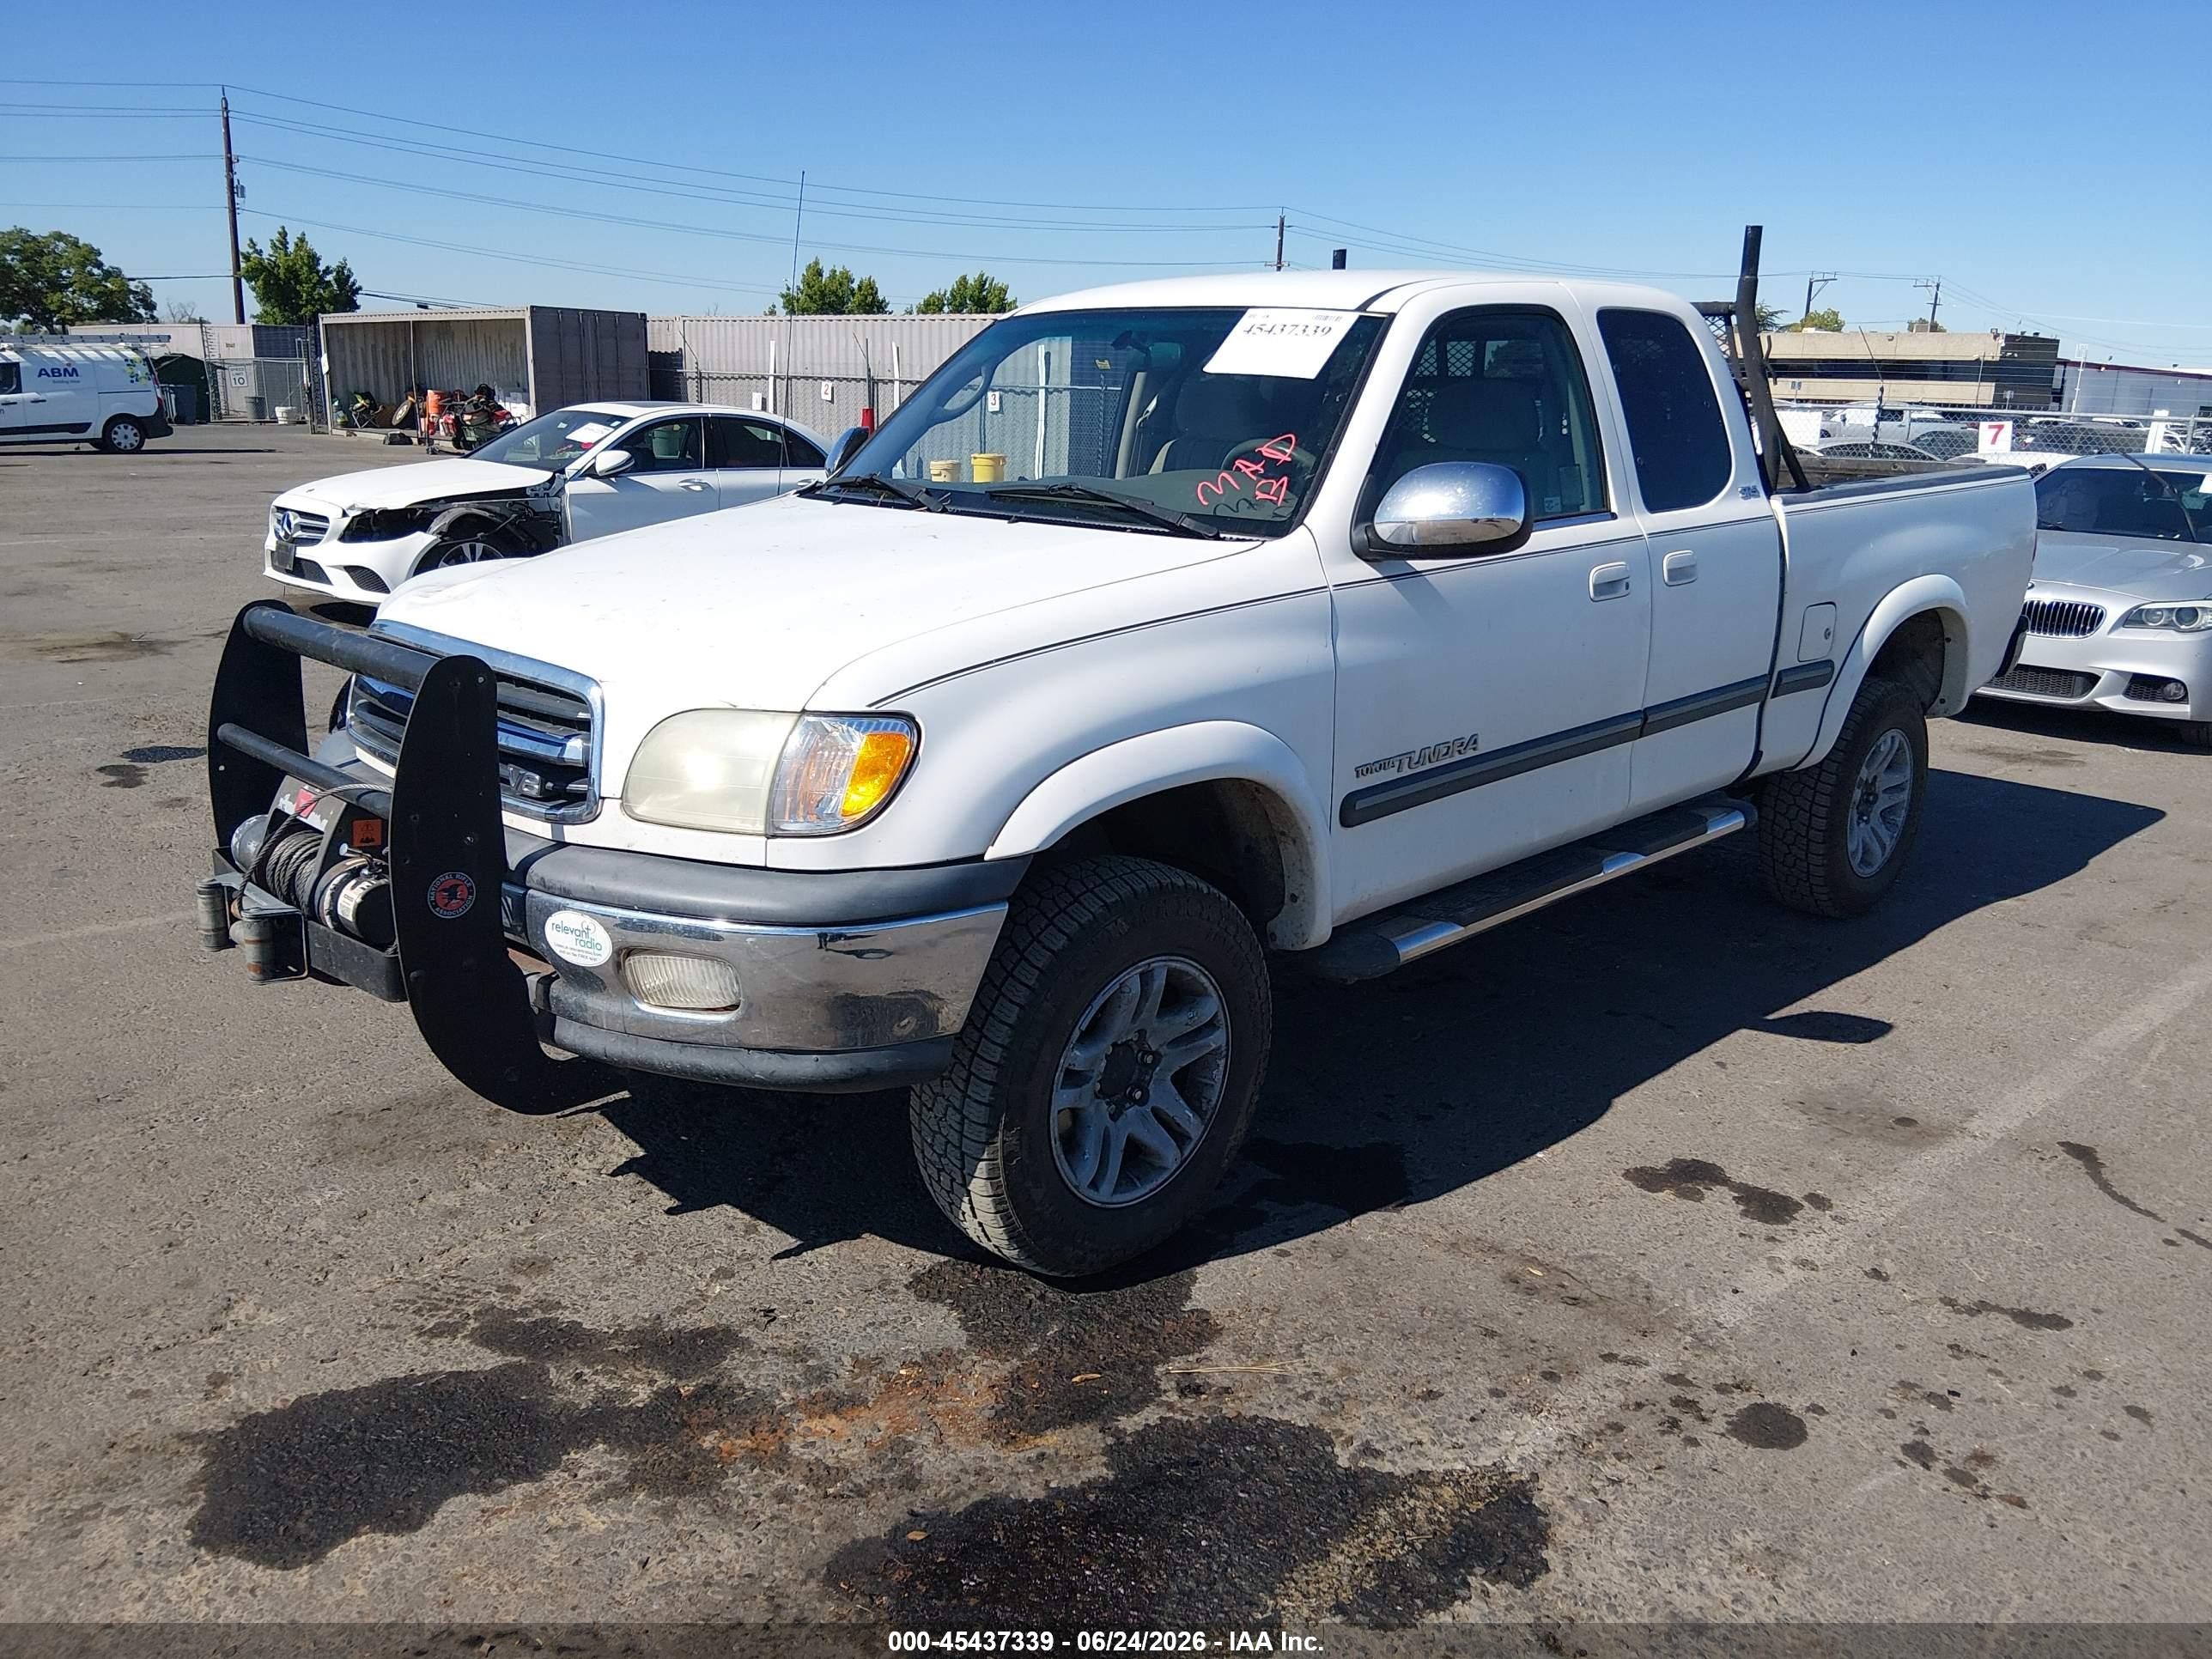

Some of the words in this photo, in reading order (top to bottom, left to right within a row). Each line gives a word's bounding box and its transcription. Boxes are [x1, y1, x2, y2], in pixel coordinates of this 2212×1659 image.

[1243, 323, 1333, 337] 45437339
[37, 367, 80, 378] ABM
[233, 377, 246, 386] 10
[823, 383, 830, 395] 2
[990, 393, 997, 406] 3
[1988, 424, 2005, 445] 7
[1354, 759, 1395, 778] TOYOTA
[1395, 732, 1480, 773] TUNDRA
[507, 763, 542, 796] V8
[430, 874, 454, 901] NATIONAL
[455, 874, 472, 888] RIFLE
[434, 895, 473, 916] ASSOCIATION
[551, 921, 591, 939] relevant
[575, 938, 603, 951] radio
